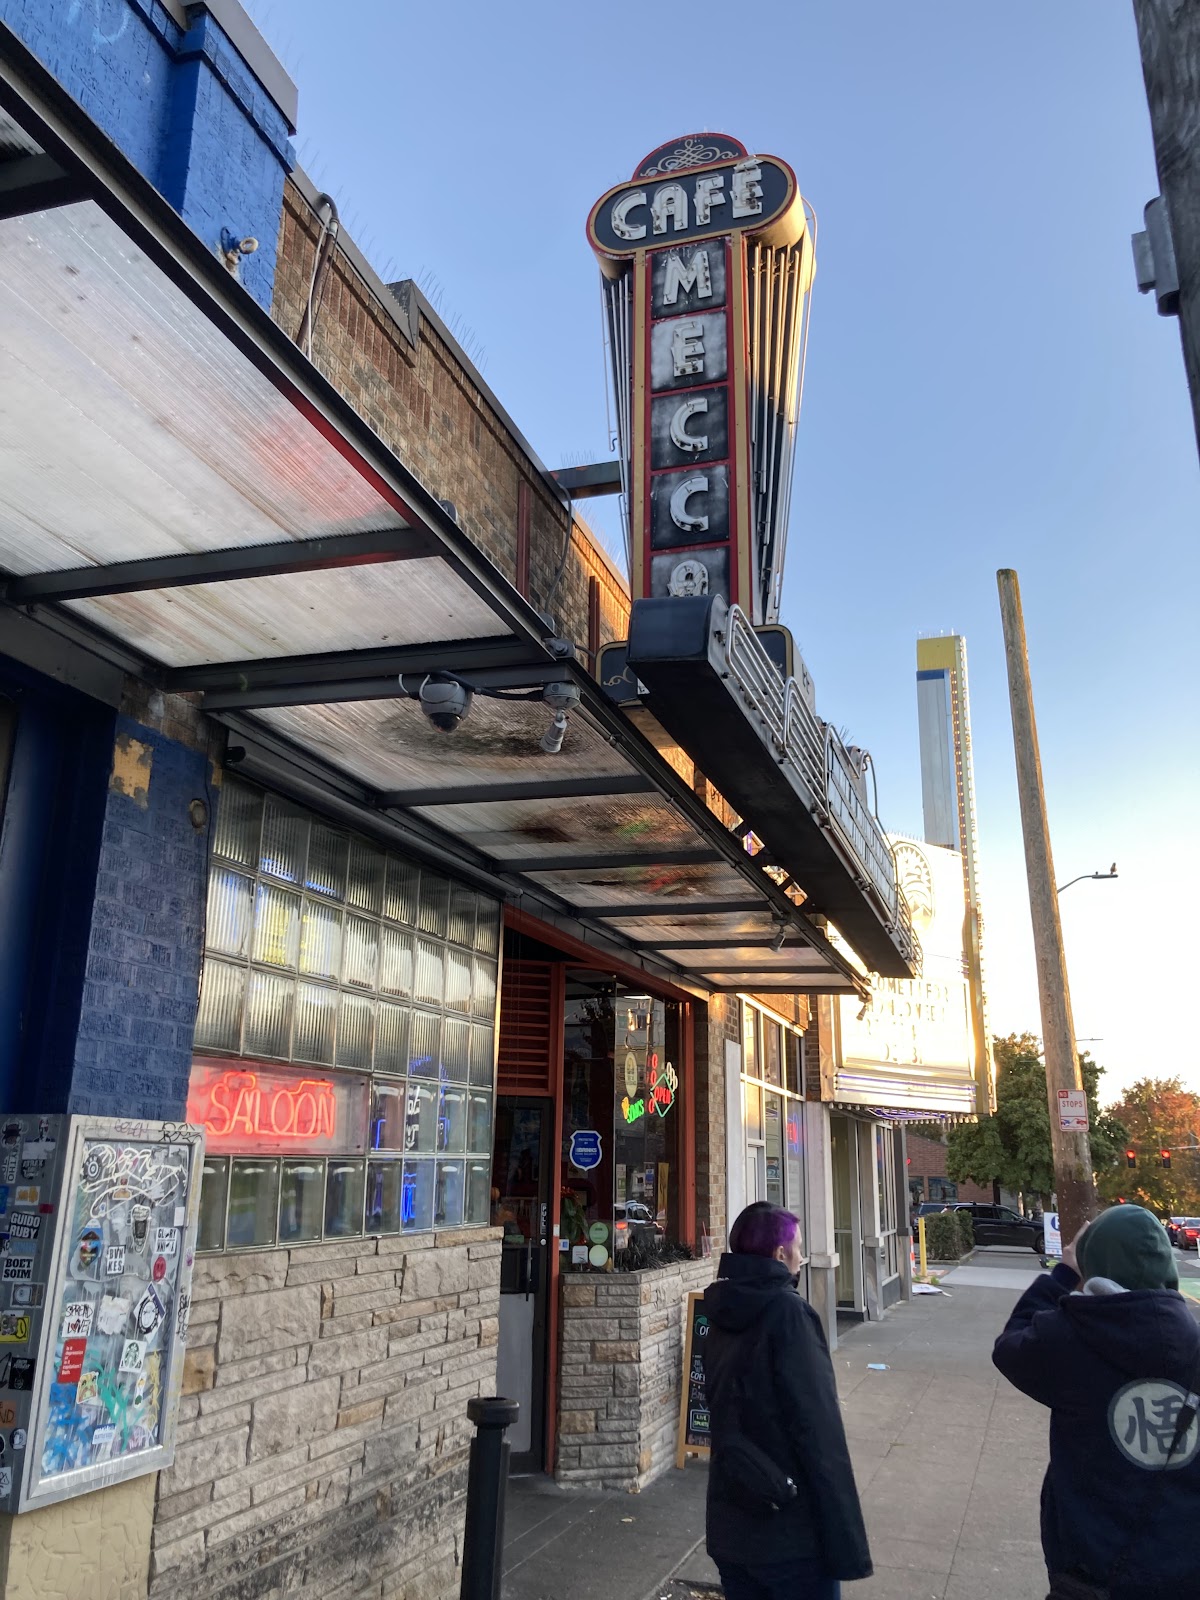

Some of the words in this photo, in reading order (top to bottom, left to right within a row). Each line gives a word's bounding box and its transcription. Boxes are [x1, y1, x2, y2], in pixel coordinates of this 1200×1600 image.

[611, 155, 764, 241] CAFÉ
[654, 1085, 671, 1104] OPEN
[205, 1080, 335, 1139] SALOON
[1062, 1100, 1083, 1108] STOPS
[10, 1213, 40, 1227] GUIDO
[10, 1223, 38, 1239] RUBY
[5, 1258, 33, 1268] BOET
[107, 1260, 123, 1272] KES
[3, 1268, 32, 1279] SOIM
[65, 1304, 94, 1318] SPREAD
